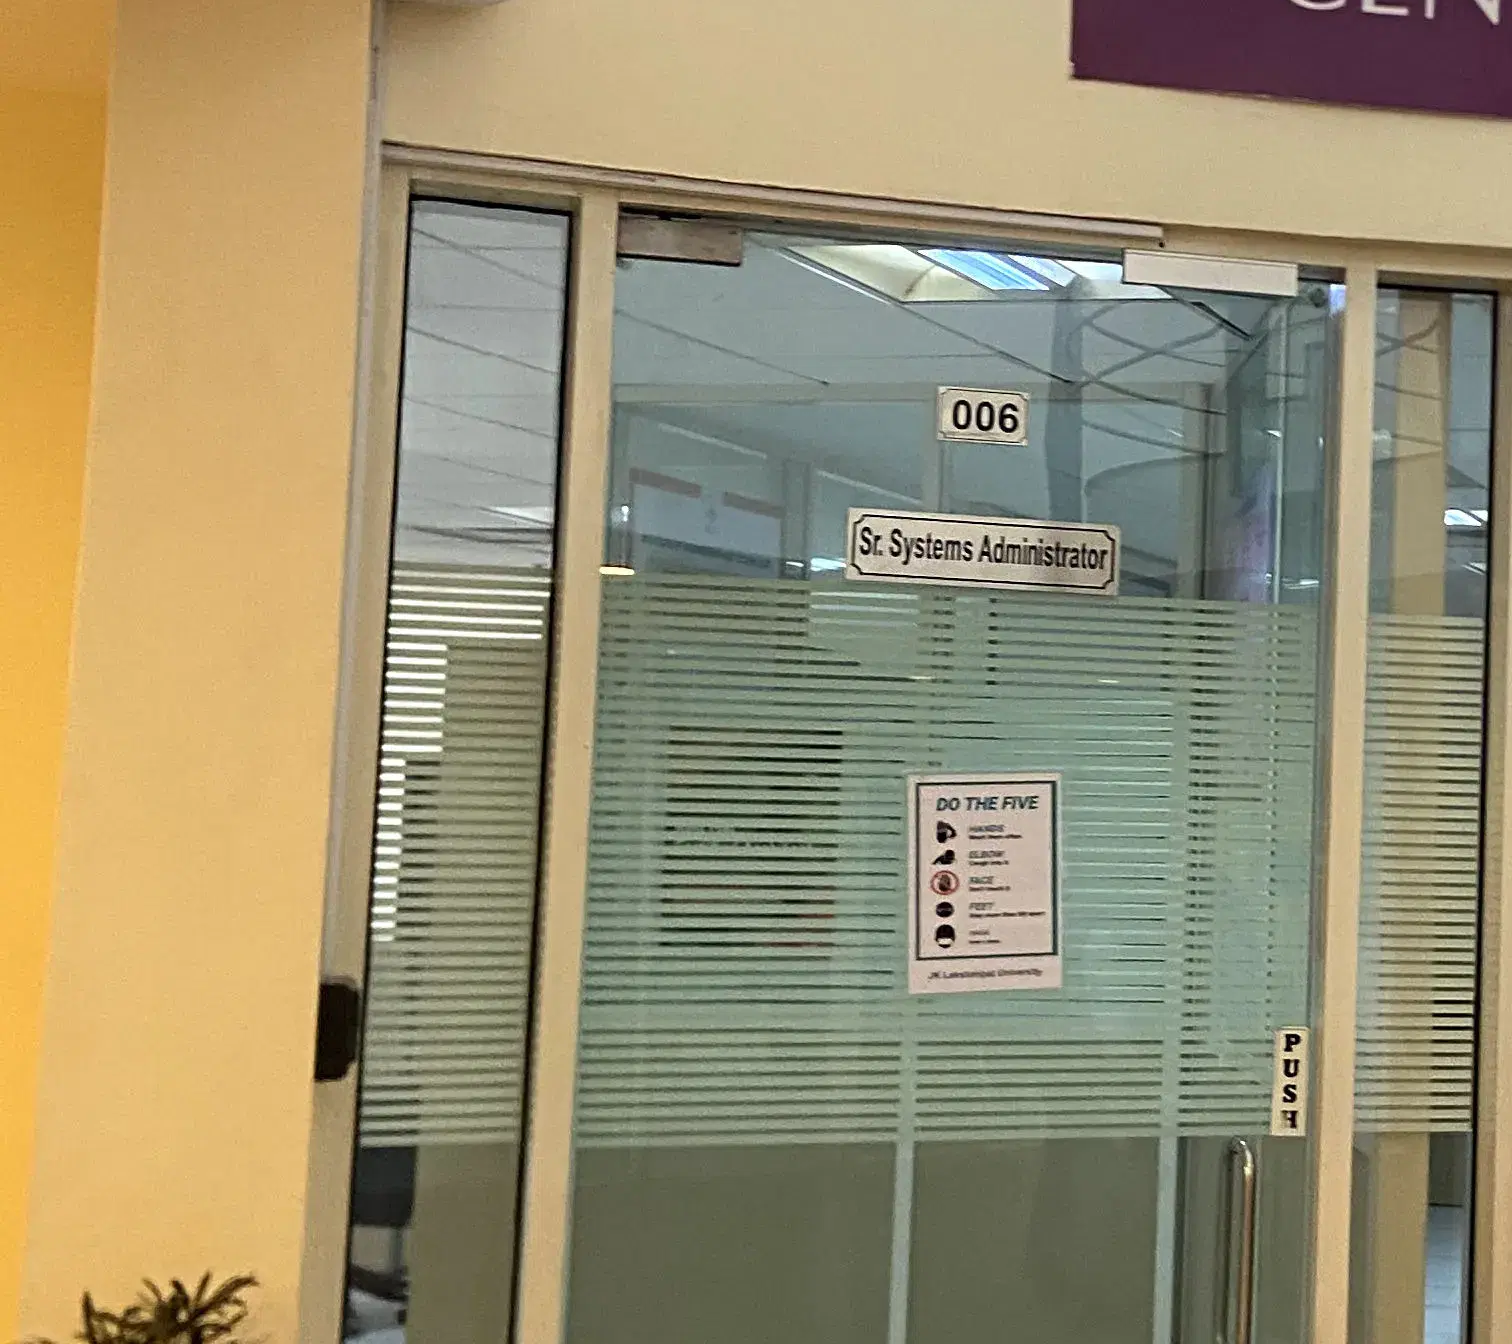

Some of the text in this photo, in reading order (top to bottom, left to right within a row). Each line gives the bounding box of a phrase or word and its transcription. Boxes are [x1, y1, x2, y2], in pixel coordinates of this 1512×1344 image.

[952, 399, 1020, 433] 006
[859, 526, 1108, 570] Sr. Systems Administrator
[936, 795, 1039, 811] DO THE FIVE
